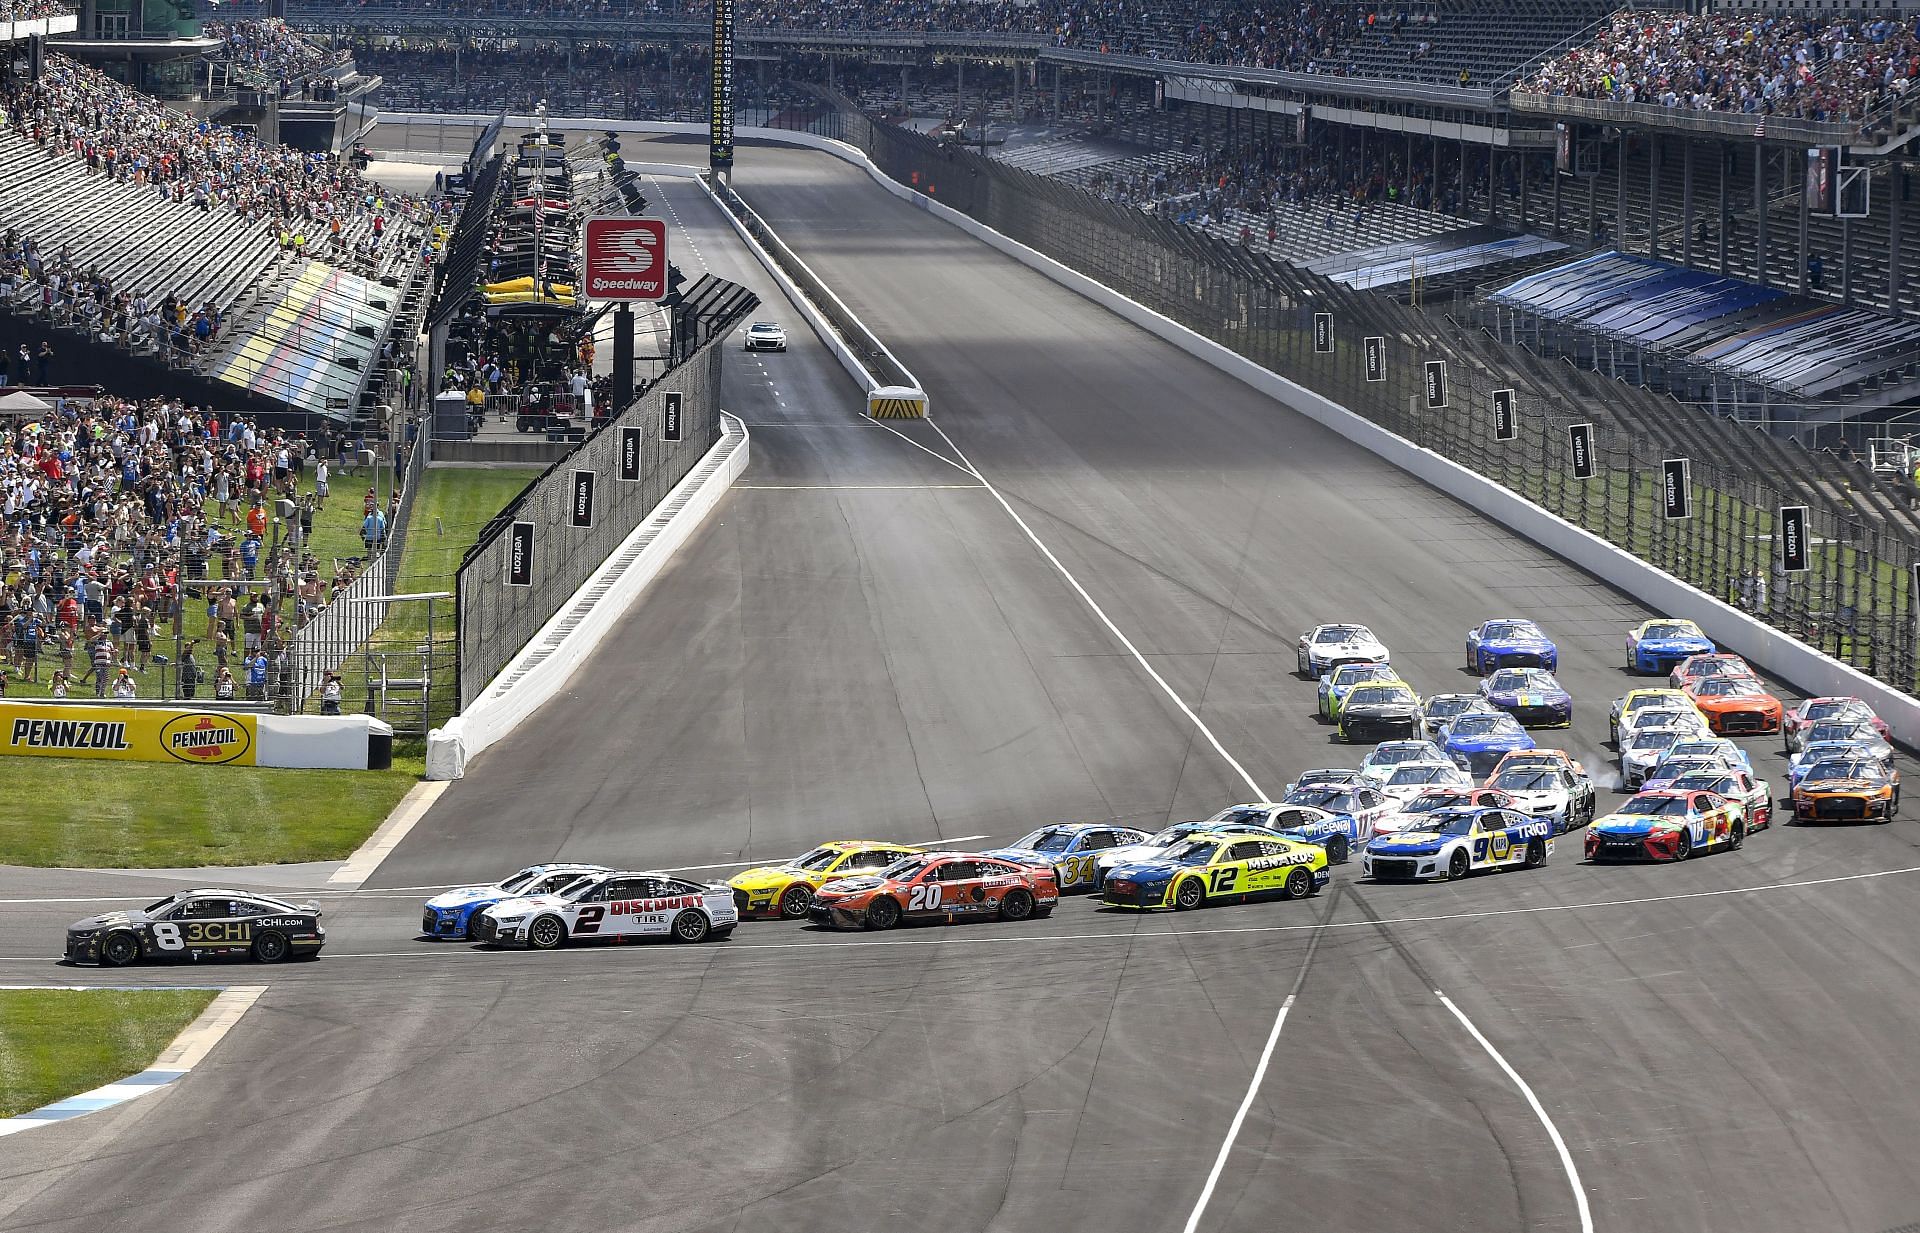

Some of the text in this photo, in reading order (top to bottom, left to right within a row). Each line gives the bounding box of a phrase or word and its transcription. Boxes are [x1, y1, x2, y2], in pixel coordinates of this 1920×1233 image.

[592, 277, 659, 292] Speedway
[1428, 371, 1436, 399] verizon
[1495, 401, 1504, 430] verizon
[626, 437, 634, 469] verizon
[1574, 435, 1584, 467] verizon
[578, 481, 588, 516] verizon
[1667, 472, 1676, 507] verizon
[1787, 519, 1799, 558] verizon
[513, 535, 524, 574] verizon
[11, 719, 129, 750] PENNZOIL
[172, 727, 237, 749] PENNZOIL
[1518, 822, 1548, 839] TRICO
[1473, 838, 1489, 861] 9
[1495, 838, 1507, 850] NAPA
[1064, 855, 1096, 884] 34
[1247, 852, 1315, 871] MENARDS
[1208, 868, 1239, 893] 12
[610, 895, 704, 916] DISCOUNT
[907, 886, 943, 911] 20
[187, 923, 251, 940] 3CHI
[256, 918, 303, 927] 3CHI.COM
[572, 906, 605, 934] 2
[634, 915, 666, 923] TIRE
[154, 922, 185, 950] 8
